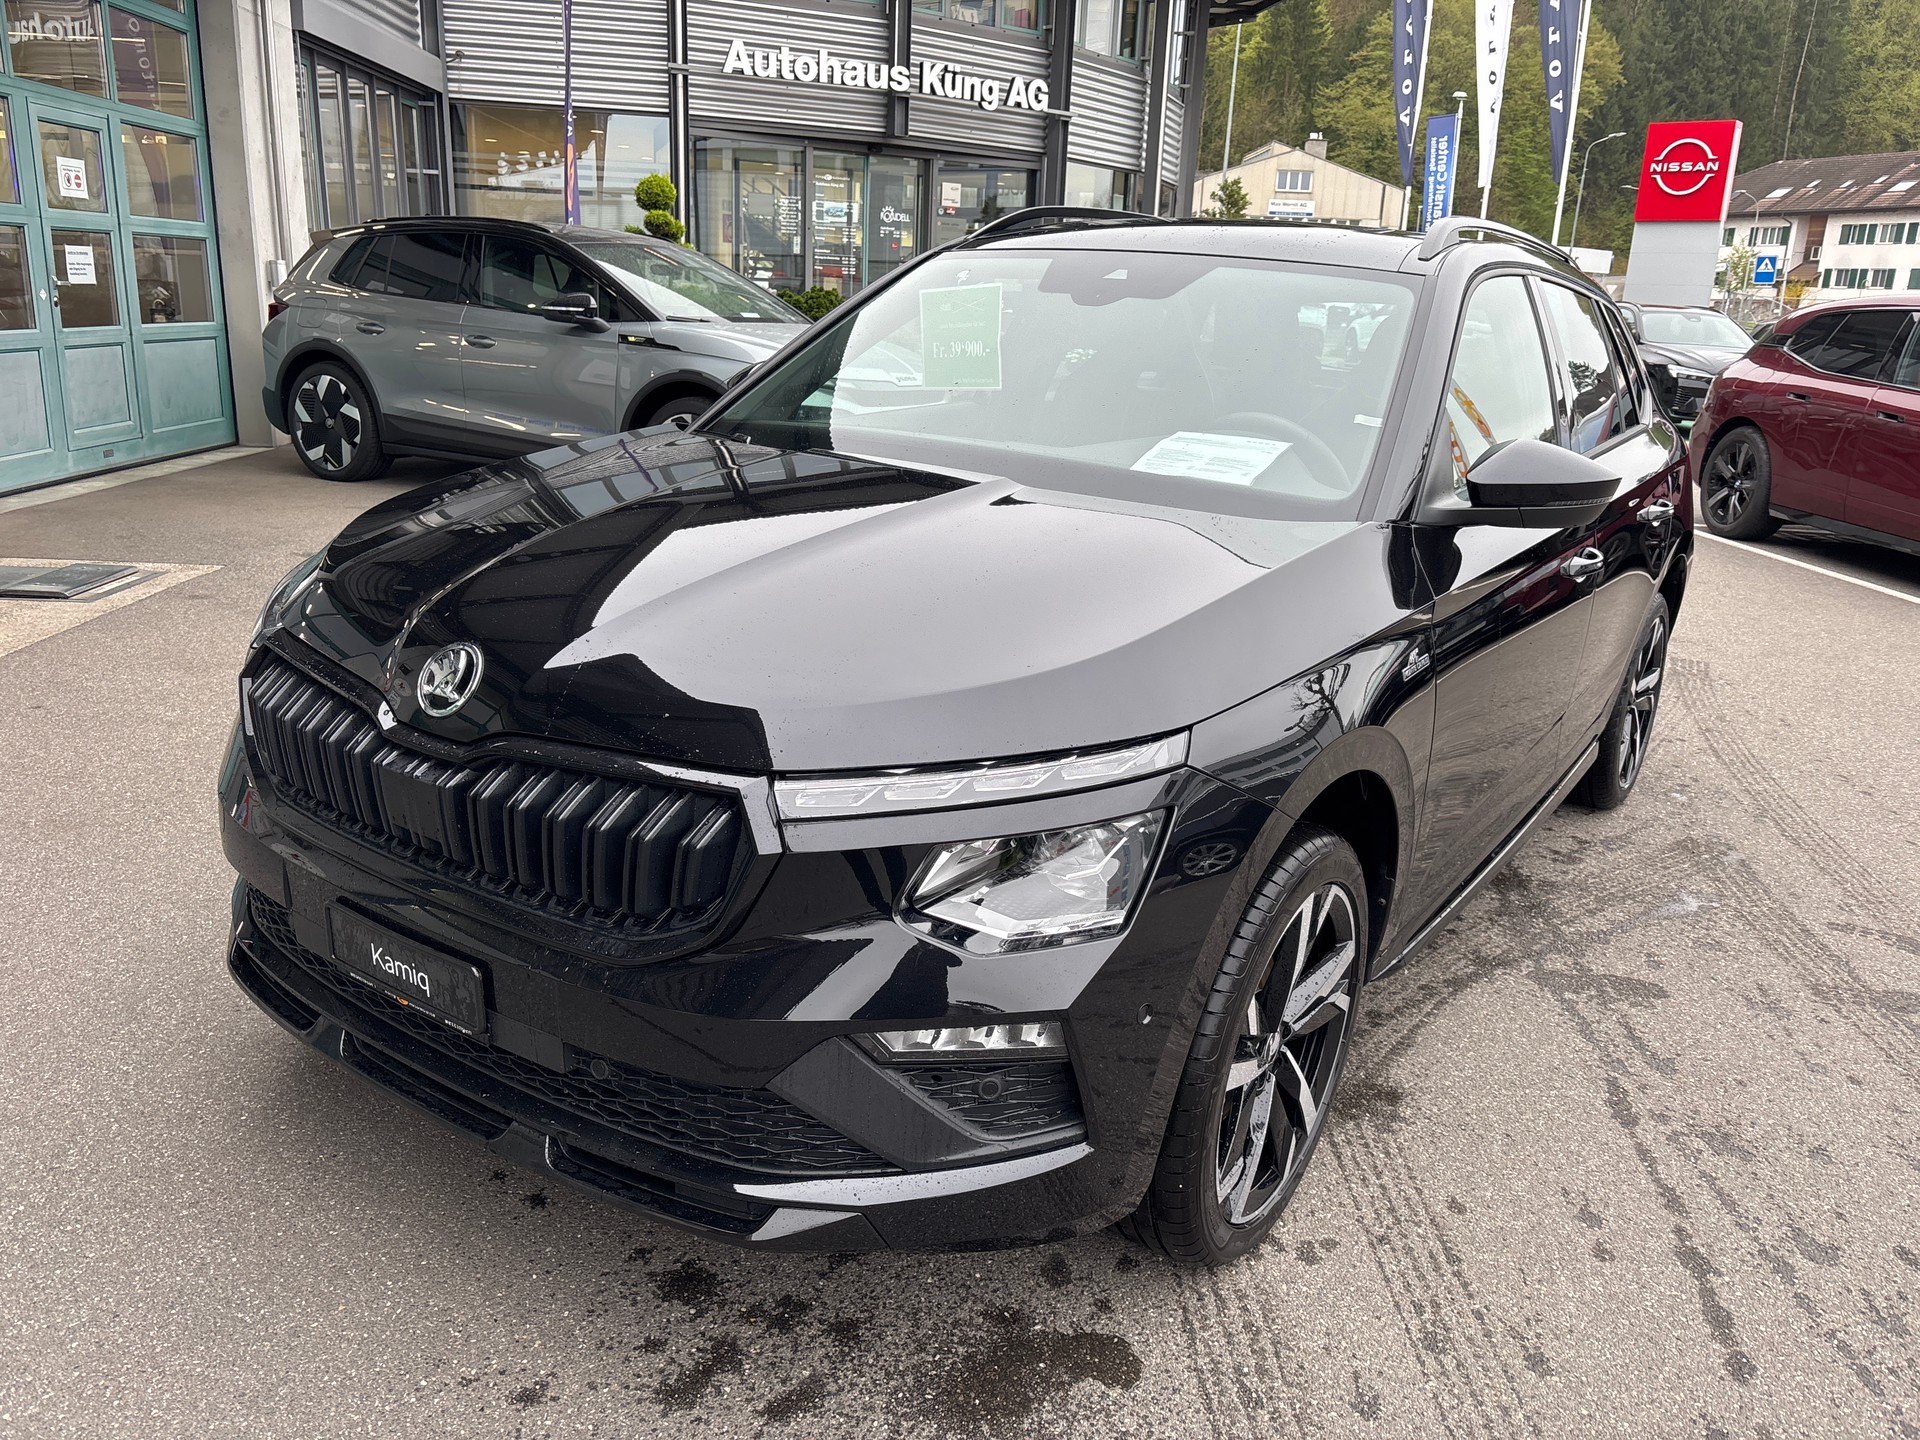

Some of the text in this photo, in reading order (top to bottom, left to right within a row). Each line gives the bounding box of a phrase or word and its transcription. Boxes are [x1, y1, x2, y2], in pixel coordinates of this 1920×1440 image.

[722, 40, 1050, 112] Autohaus Küng AG
[1649, 161, 1720, 173] NISSAN
[933, 342, 948, 358] Fr.
[370, 943, 431, 998] Kamiq
